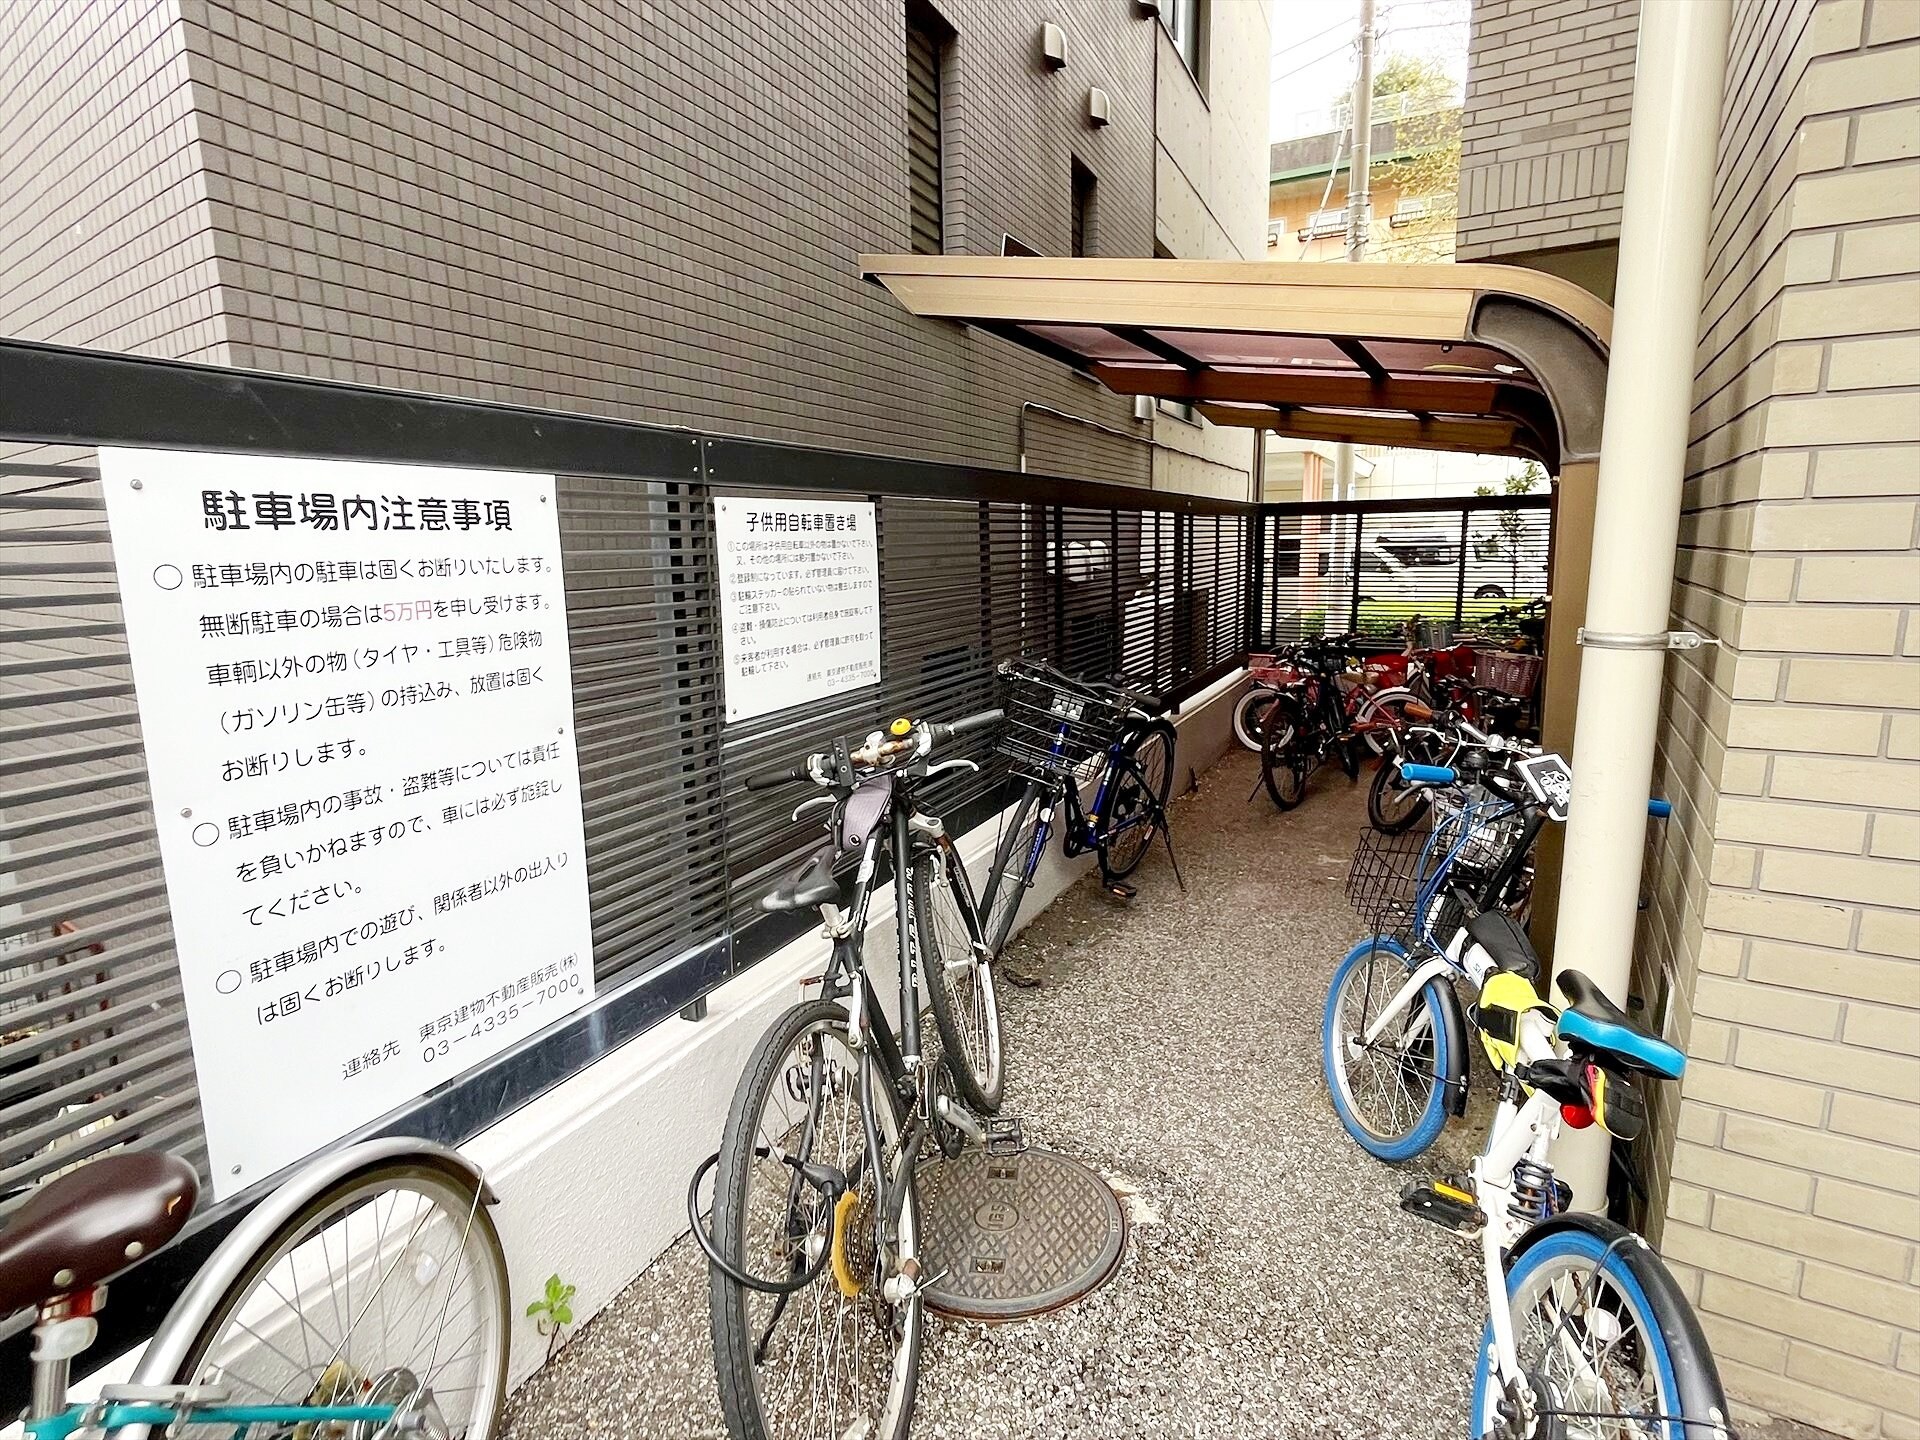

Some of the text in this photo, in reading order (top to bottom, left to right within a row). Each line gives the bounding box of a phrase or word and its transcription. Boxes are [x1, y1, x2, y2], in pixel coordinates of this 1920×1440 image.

[201, 490, 512, 531] 駐車場内注意事項
[746, 512, 856, 532] 子供用自転車置き場
[192, 556, 551, 588] 駐車場内の駐車は固くお断りいたします。
[199, 594, 549, 638] 無断駐車の場合は5万円を申し受けます。
[739, 637, 756, 647] さい。
[221, 666, 543, 734] （ガソリン缶等）の持込み、放置は固く
[222, 738, 365, 781] お断りします。
[228, 741, 560, 840] 駐車場内の事故・盗難等については責任
[236, 780, 562, 882] を負いかねますので、車には必ず施錠し
[242, 881, 361, 925] てください。
[250, 852, 567, 983] 駐車場内での遊び、関係者以外の出入り
[258, 939, 444, 1025] は固くお断りします。
[424, 974, 578, 1063] 03-4335-7000
[342, 1040, 400, 1080] 連絡先
